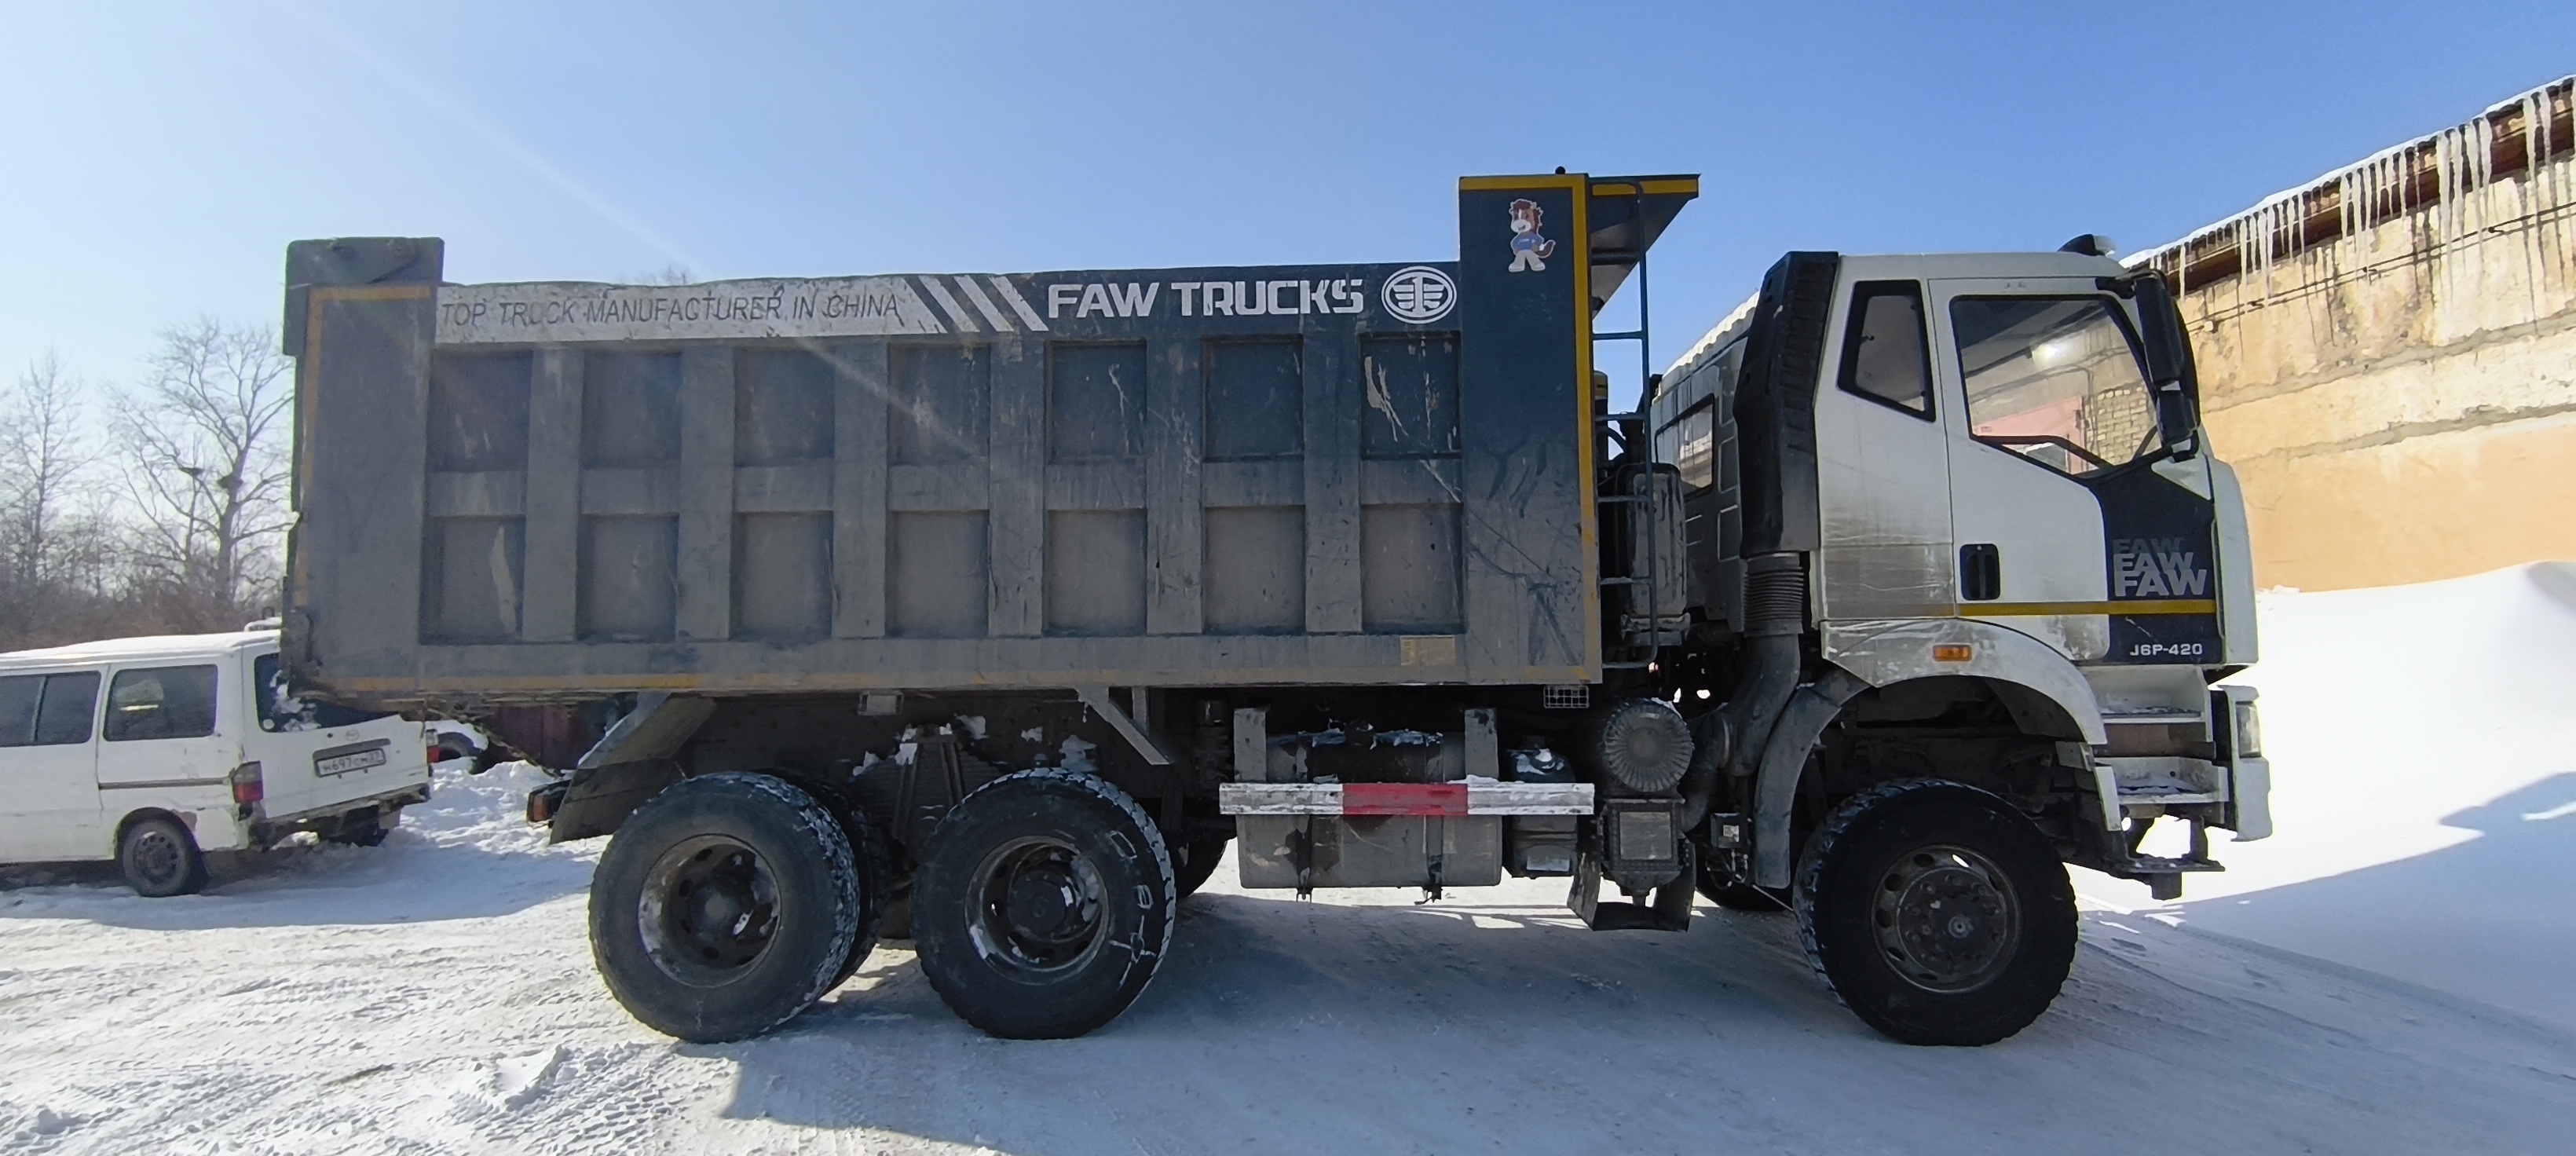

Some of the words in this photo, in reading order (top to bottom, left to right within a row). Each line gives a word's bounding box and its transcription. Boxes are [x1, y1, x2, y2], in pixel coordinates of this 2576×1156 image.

[442, 302, 487, 327] TOP
[499, 300, 575, 327] TRUCK
[587, 296, 783, 323] MANUFACTURER
[792, 295, 815, 320] IN
[827, 293, 901, 320] CHINA
[1048, 282, 1160, 319] FAW
[1171, 278, 1363, 316] TRUCKS
[2113, 537, 2184, 553] FAW
[2113, 552, 2194, 572] FAW
[2114, 569, 2208, 597] FAW
[2129, 643, 2203, 657] J6P-420
